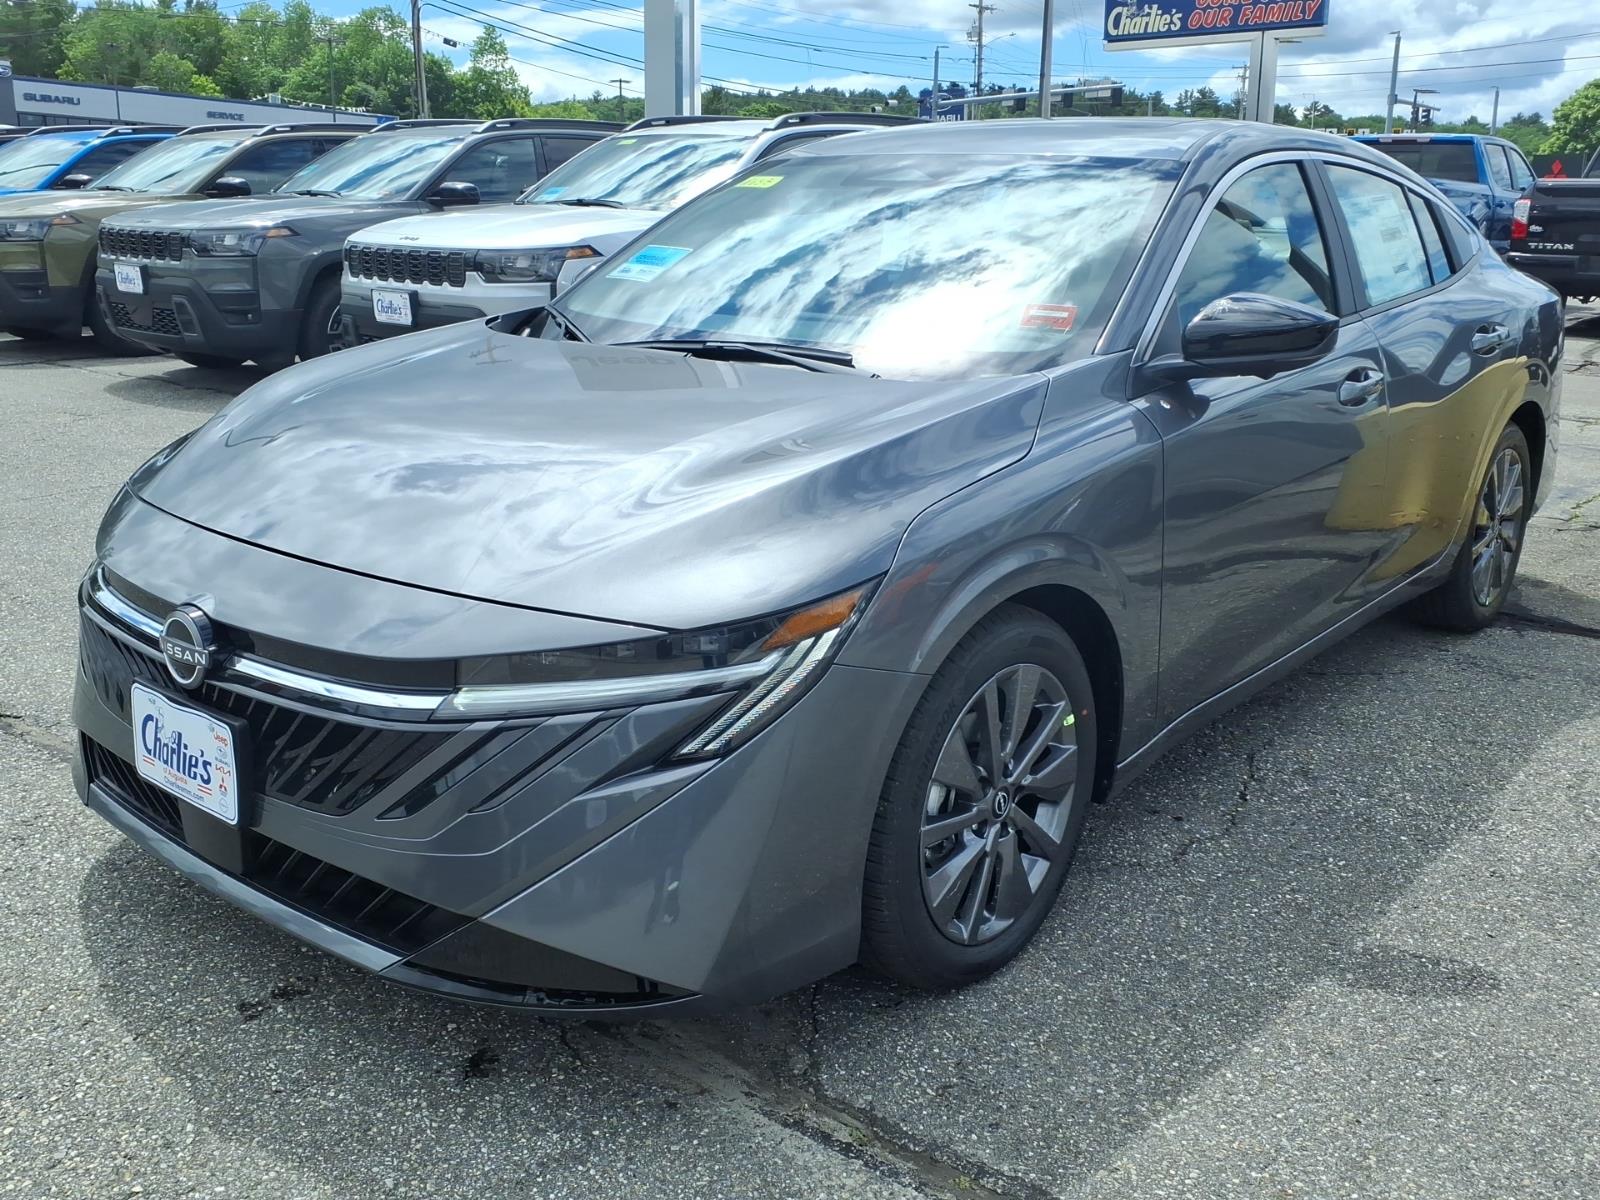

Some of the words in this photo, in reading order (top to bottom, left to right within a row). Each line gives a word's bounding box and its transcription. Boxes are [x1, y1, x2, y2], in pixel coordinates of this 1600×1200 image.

[1107, 6, 1183, 37] Charlie's
[1188, 7, 1232, 30] OUR
[1238, 0, 1321, 26] FAMILY
[22, 92, 81, 106] SUBARU
[206, 111, 245, 121] SERVICE
[1527, 242, 1575, 250] TITAN
[376, 298, 402, 316] Charlie's
[141, 713, 212, 786] Charlie's
